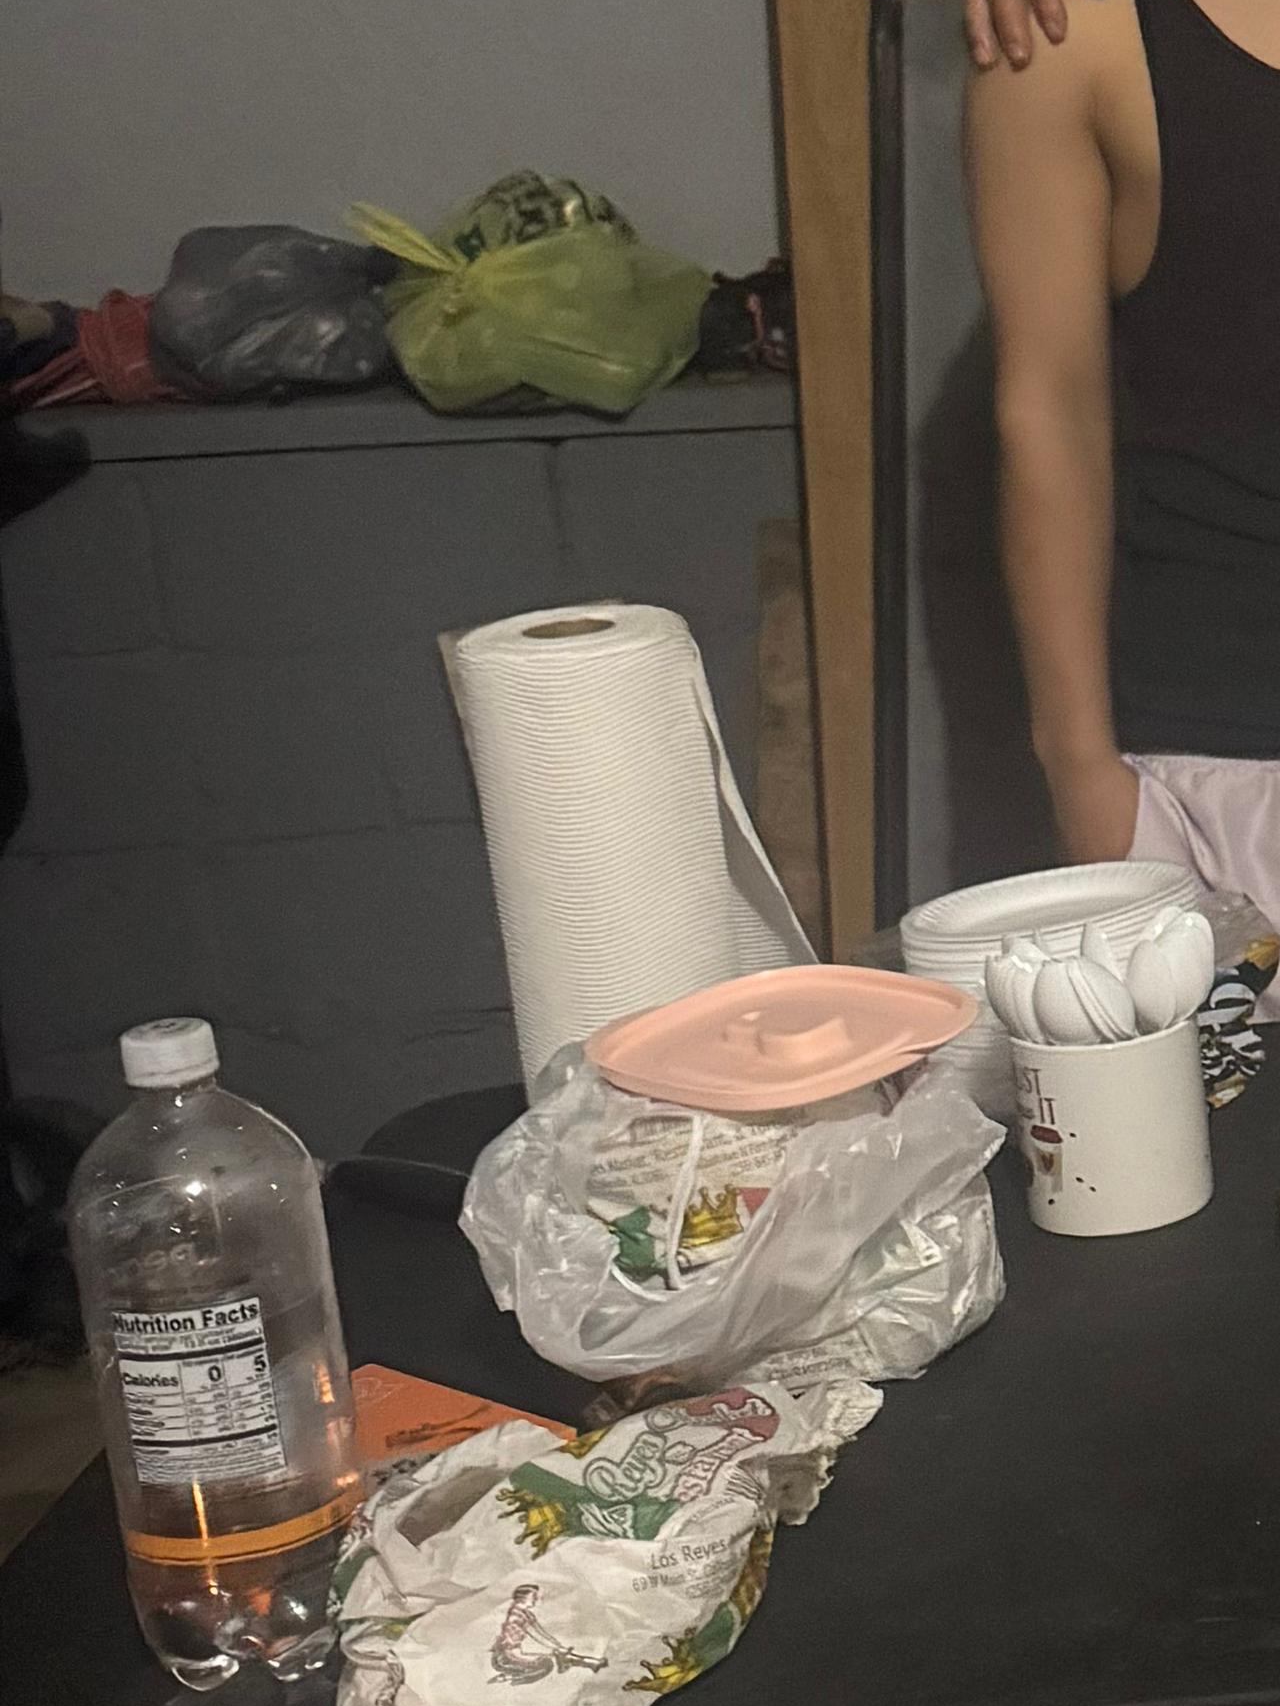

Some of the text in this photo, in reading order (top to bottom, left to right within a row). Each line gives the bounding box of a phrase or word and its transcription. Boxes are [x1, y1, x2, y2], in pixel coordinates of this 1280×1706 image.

[1039, 1097, 1056, 1125] IT
[114, 1302, 259, 1334] Nutrition Facts
[123, 1372, 178, 1388] Calories
[208, 1365, 222, 1382] 0
[254, 1354, 267, 1372] 5
[650, 1539, 728, 1570] Los Reyes
